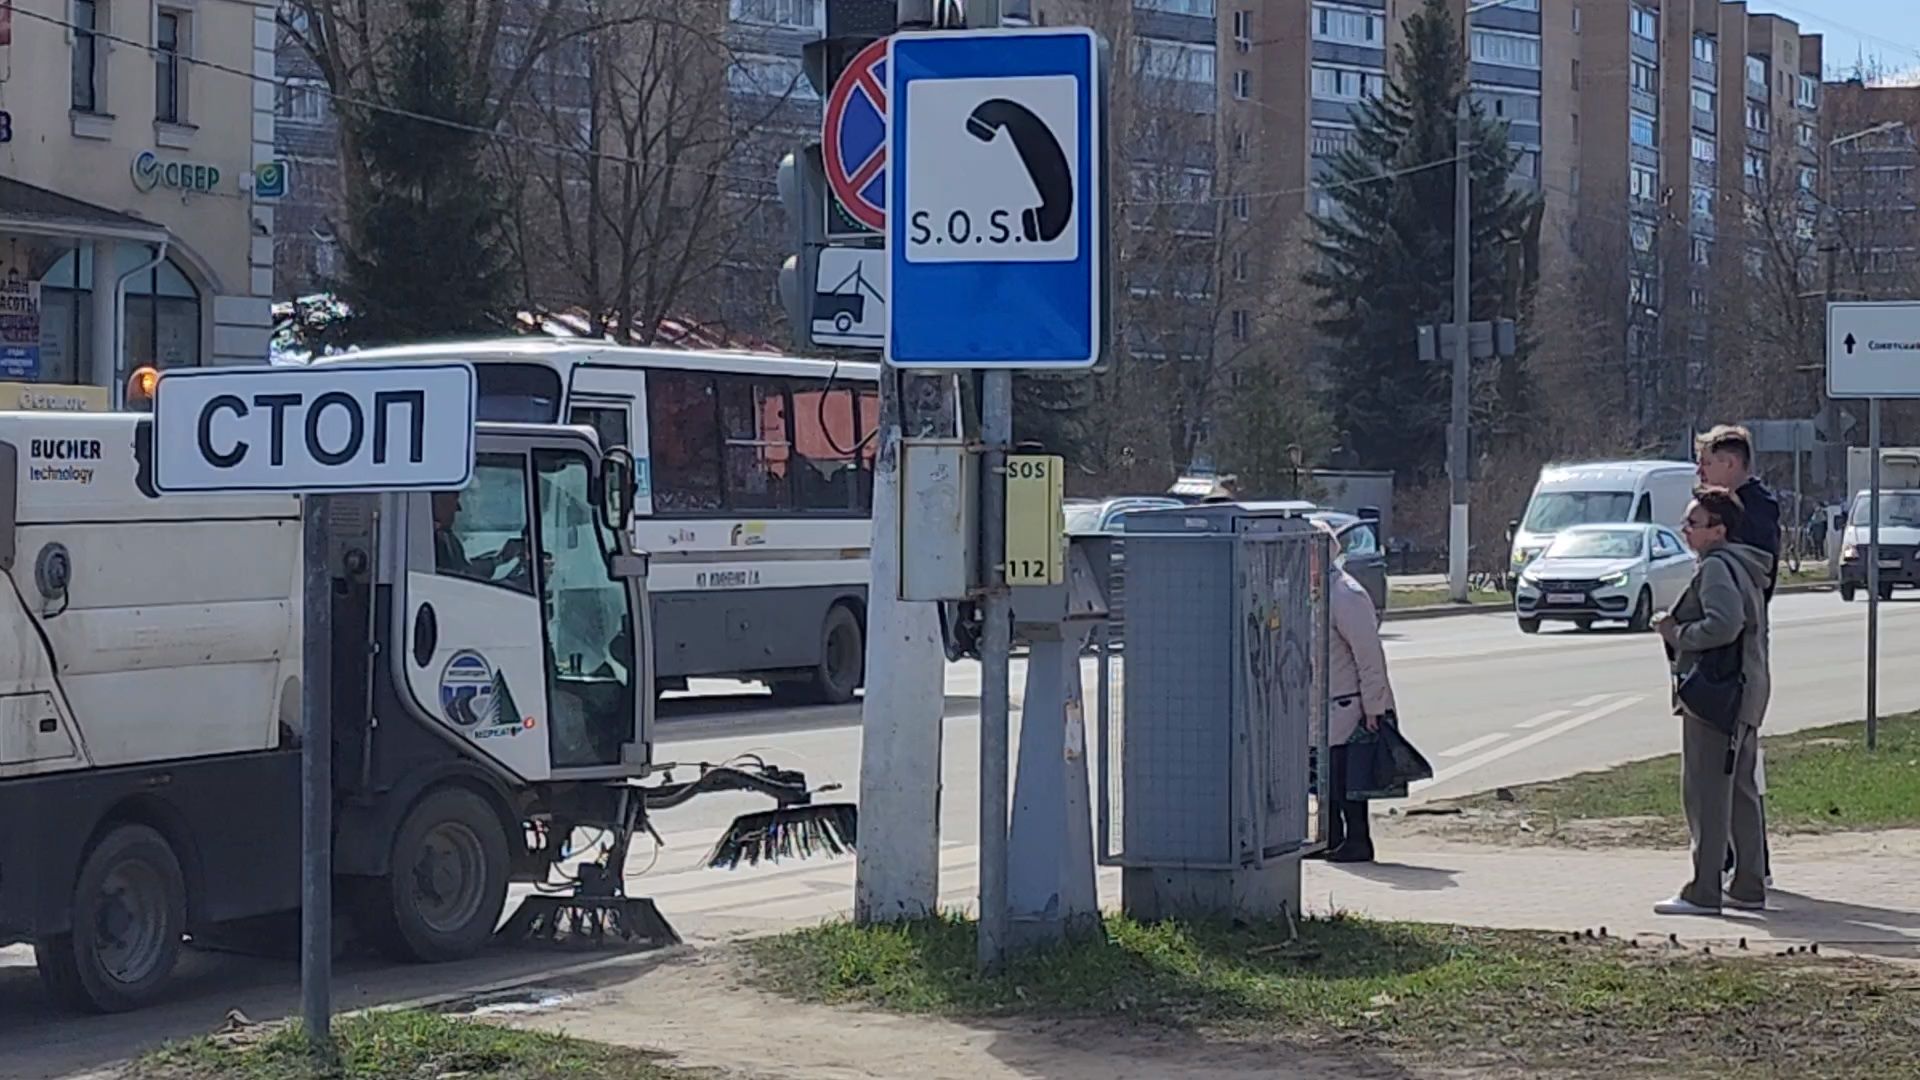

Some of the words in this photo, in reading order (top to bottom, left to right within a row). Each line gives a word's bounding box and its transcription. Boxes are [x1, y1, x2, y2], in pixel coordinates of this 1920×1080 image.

[165, 162, 220, 190] СБЕР
[910, 210, 1022, 245] S.O.S.
[197, 390, 425, 469] СТОП
[31, 439, 101, 459] BUCHER
[30, 464, 94, 485] technology
[1007, 461, 1046, 479] SOS
[1008, 560, 1046, 578] 112
